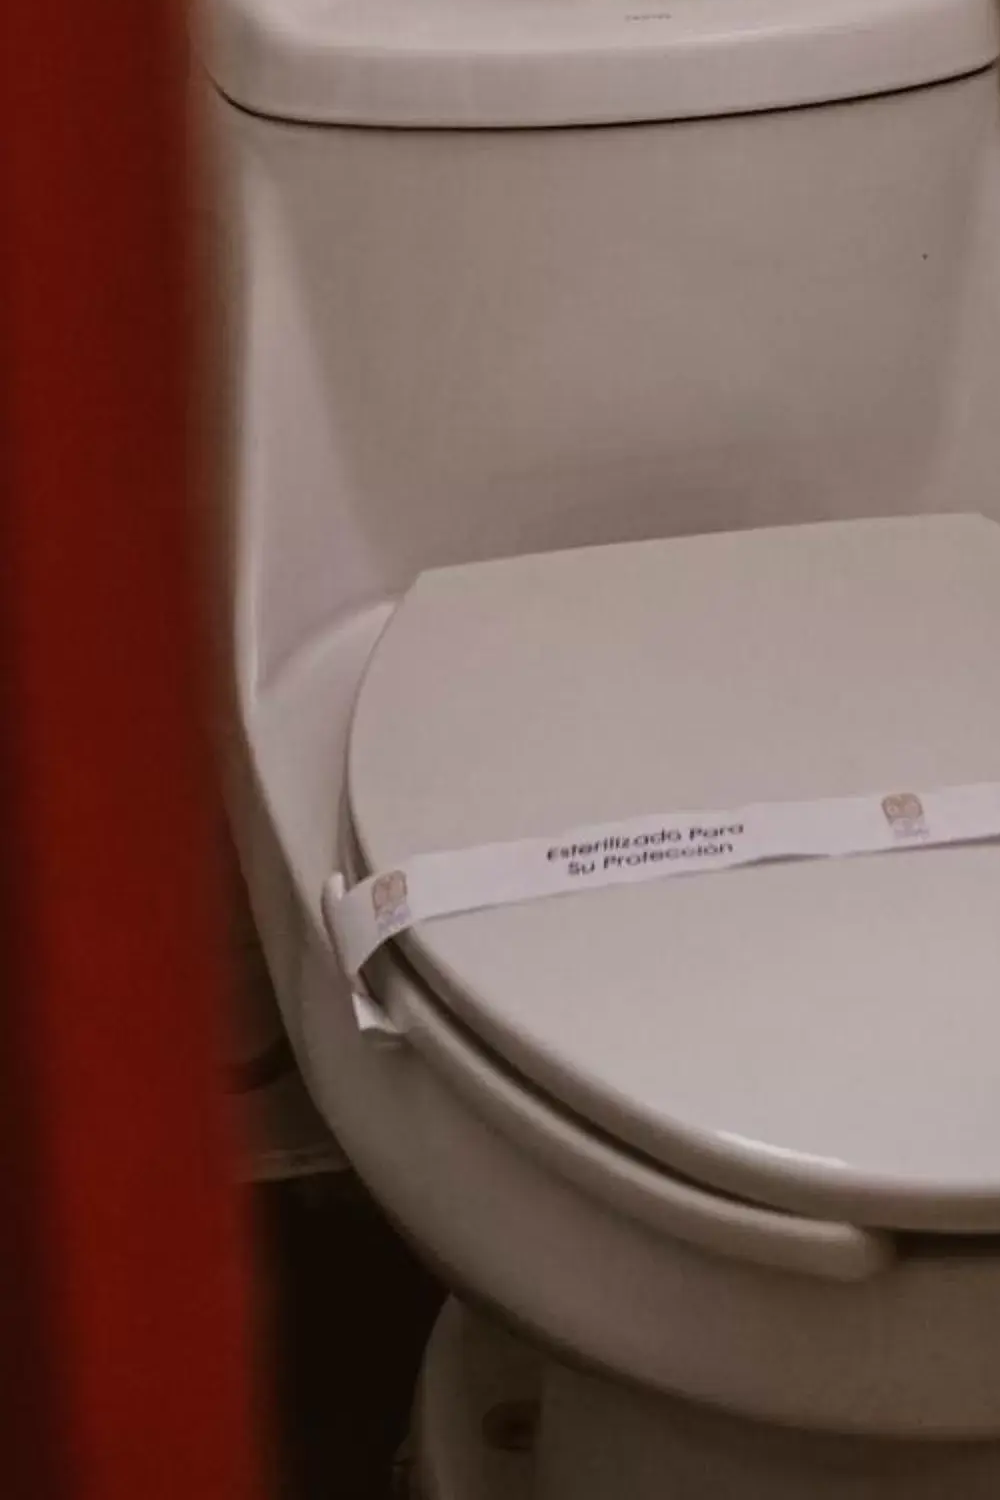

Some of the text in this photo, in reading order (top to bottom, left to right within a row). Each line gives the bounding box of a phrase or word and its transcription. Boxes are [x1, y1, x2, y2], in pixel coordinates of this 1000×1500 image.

[547, 823, 744, 861] Esterilizado Para
[567, 859, 596, 877] Su
